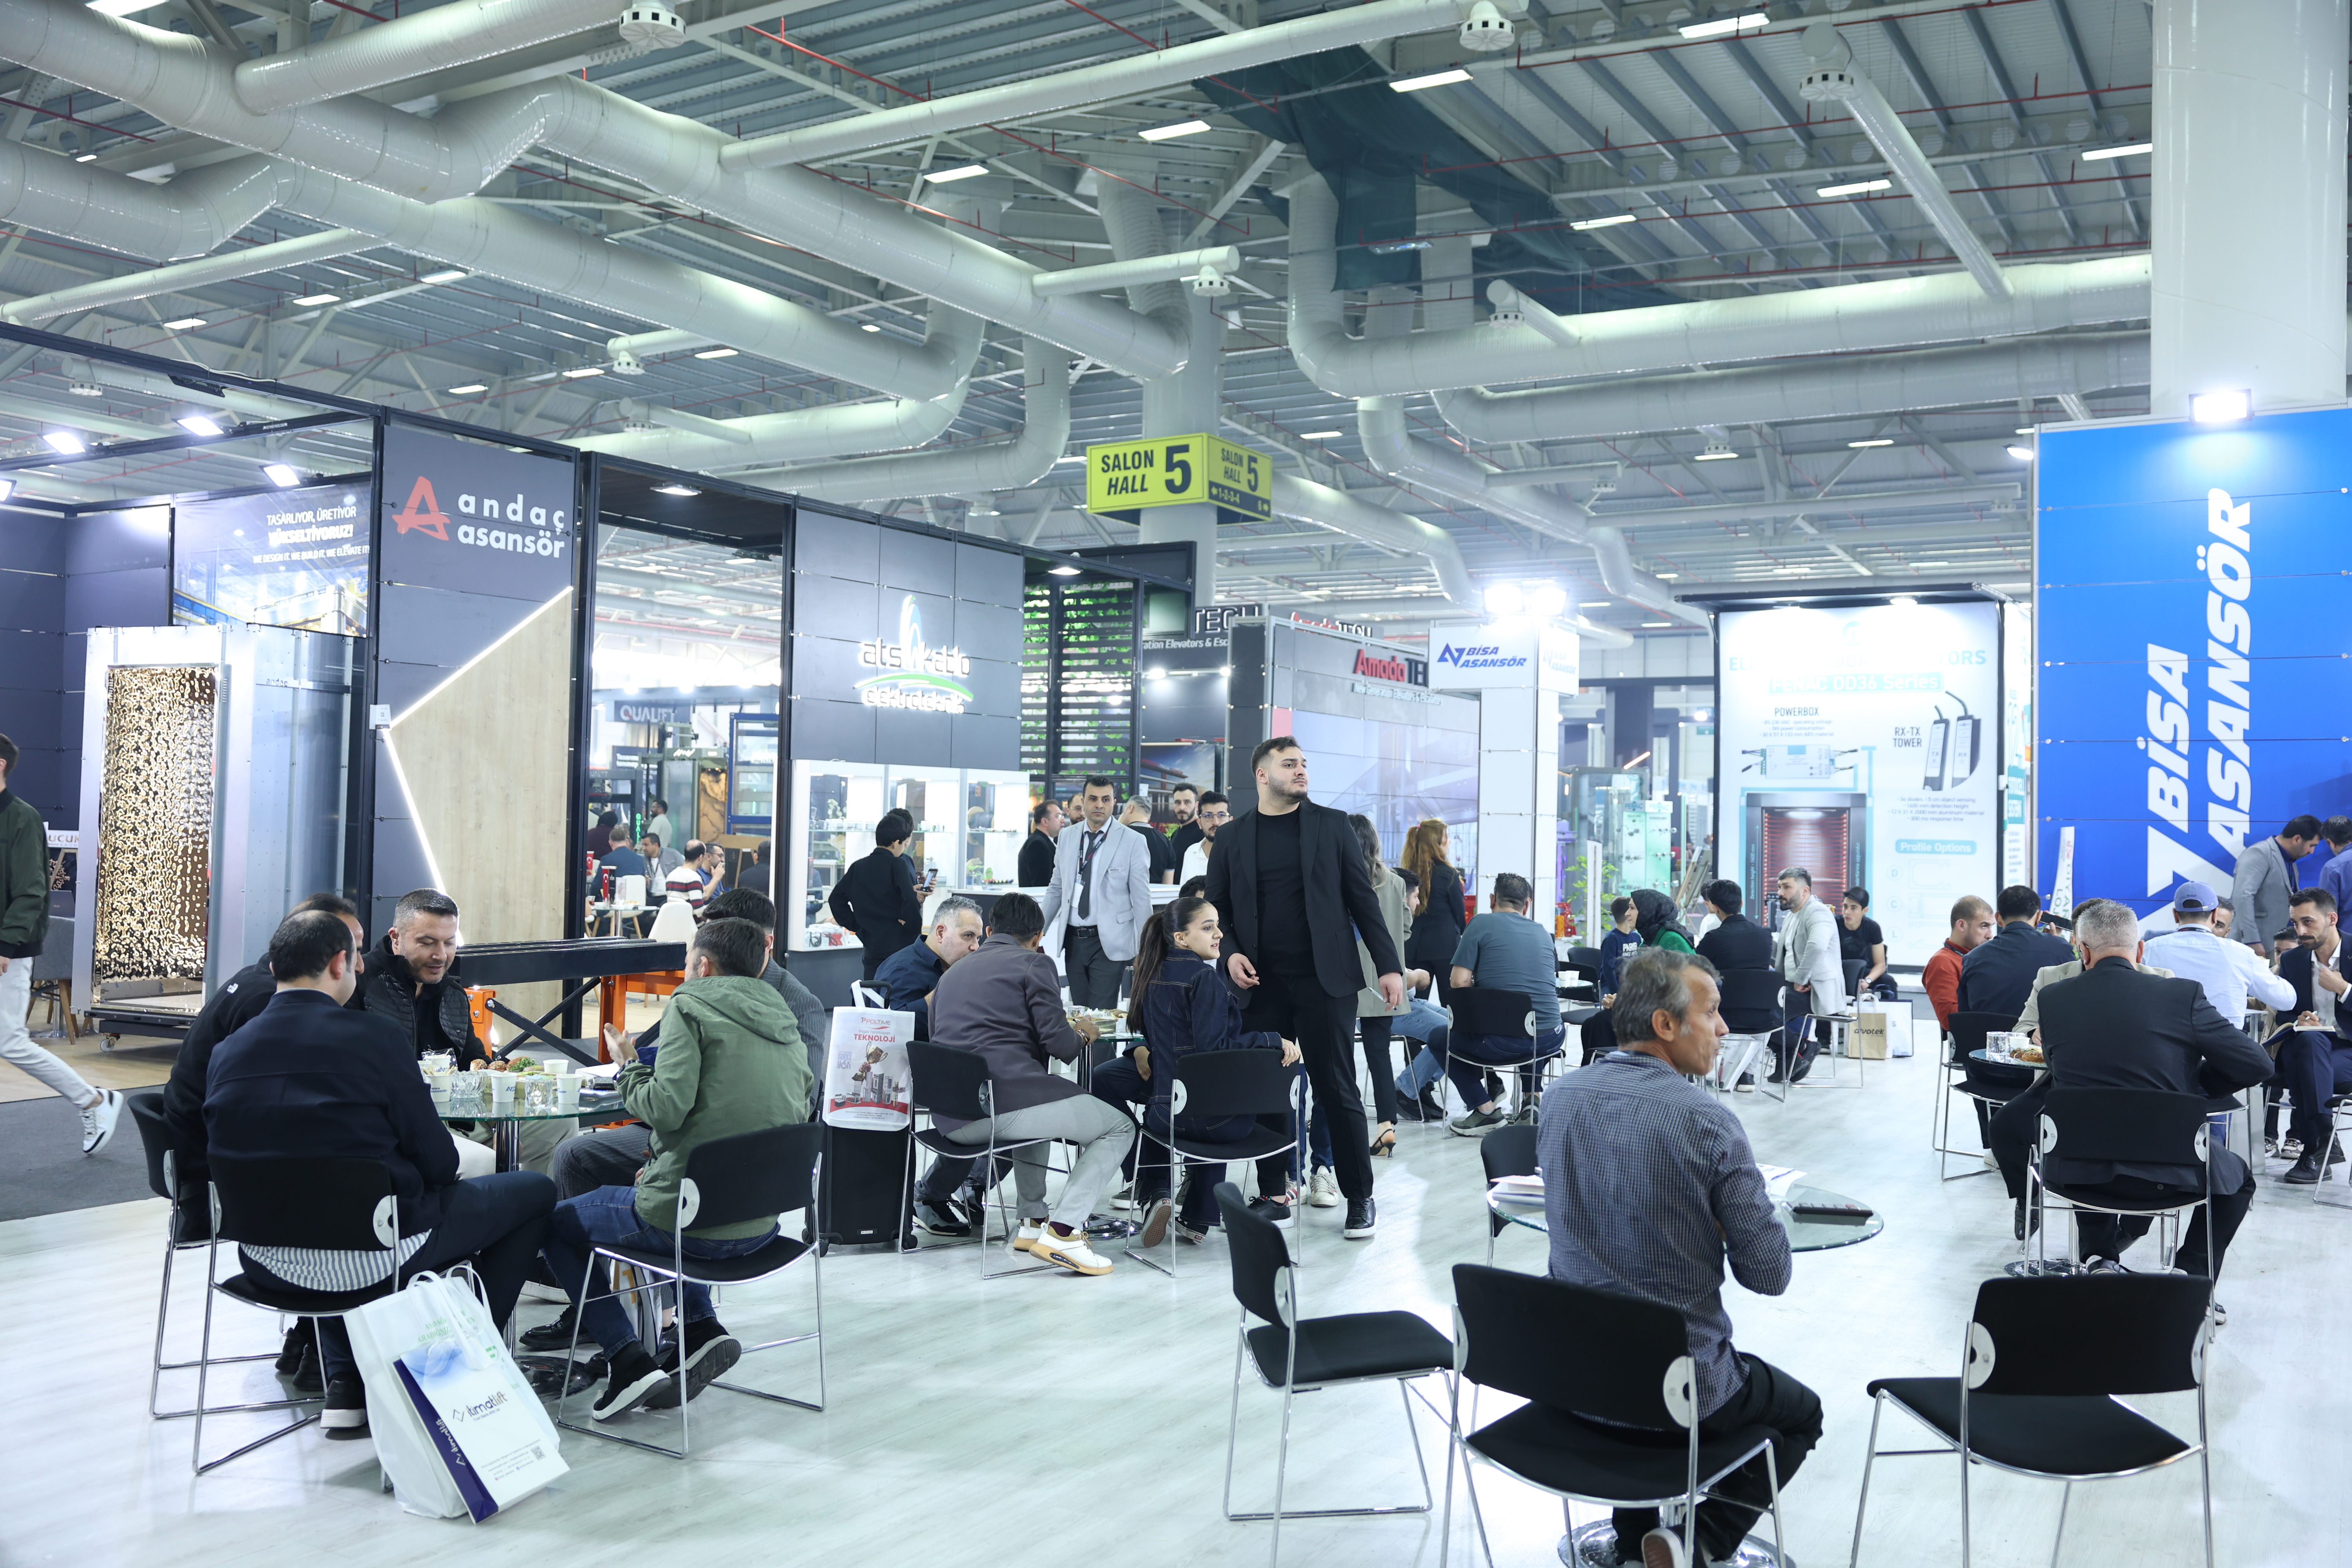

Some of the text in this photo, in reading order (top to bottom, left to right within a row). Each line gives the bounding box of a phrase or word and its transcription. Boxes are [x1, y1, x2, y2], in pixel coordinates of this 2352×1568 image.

[1102, 444, 1192, 494] SALON 5
[1221, 448, 1258, 492] SALON 5
[1224, 465, 1241, 483] HALL
[1107, 474, 1148, 495] HALL
[1218, 488, 1240, 504] 1-2-3-4
[267, 505, 356, 526] TASARLIYOR, ÜRETİYOR
[458, 493, 564, 536] andaç
[268, 524, 353, 545] YÜKSELTİYORUZ!
[457, 523, 565, 558] asansör
[253, 555, 263, 563] WE
[263, 553, 283, 563] DESIGN
[291, 551, 301, 560] WE
[301, 550, 318, 559] BUILD
[326, 549, 336, 557] WE
[337, 546, 361, 556] ELEVATE
[1142, 637, 1229, 650] ration Elevators & Esc
[1466, 645, 1499, 655] BİSA
[1354, 649, 1406, 682] Amada
[1459, 656, 1526, 668] ASANSÖR
[2196, 488, 2251, 859] ASANSÖR
[1352, 682, 1366, 693] New
[1833, 675, 1877, 691] DD36
[1884, 674, 1938, 690] Series
[1775, 707, 1819, 716] POWERBOX
[1895, 727, 1921, 736] RX-TX
[2136, 643, 2189, 833] BİSA
[1893, 738, 1922, 747] TOWER
[1901, 842, 1972, 853] Profile Options
[1622, 942, 1637, 952] PARIS
[854, 1034, 896, 1042] TEKNOLOJİ
[466, 1391, 508, 1417] itimatlift
